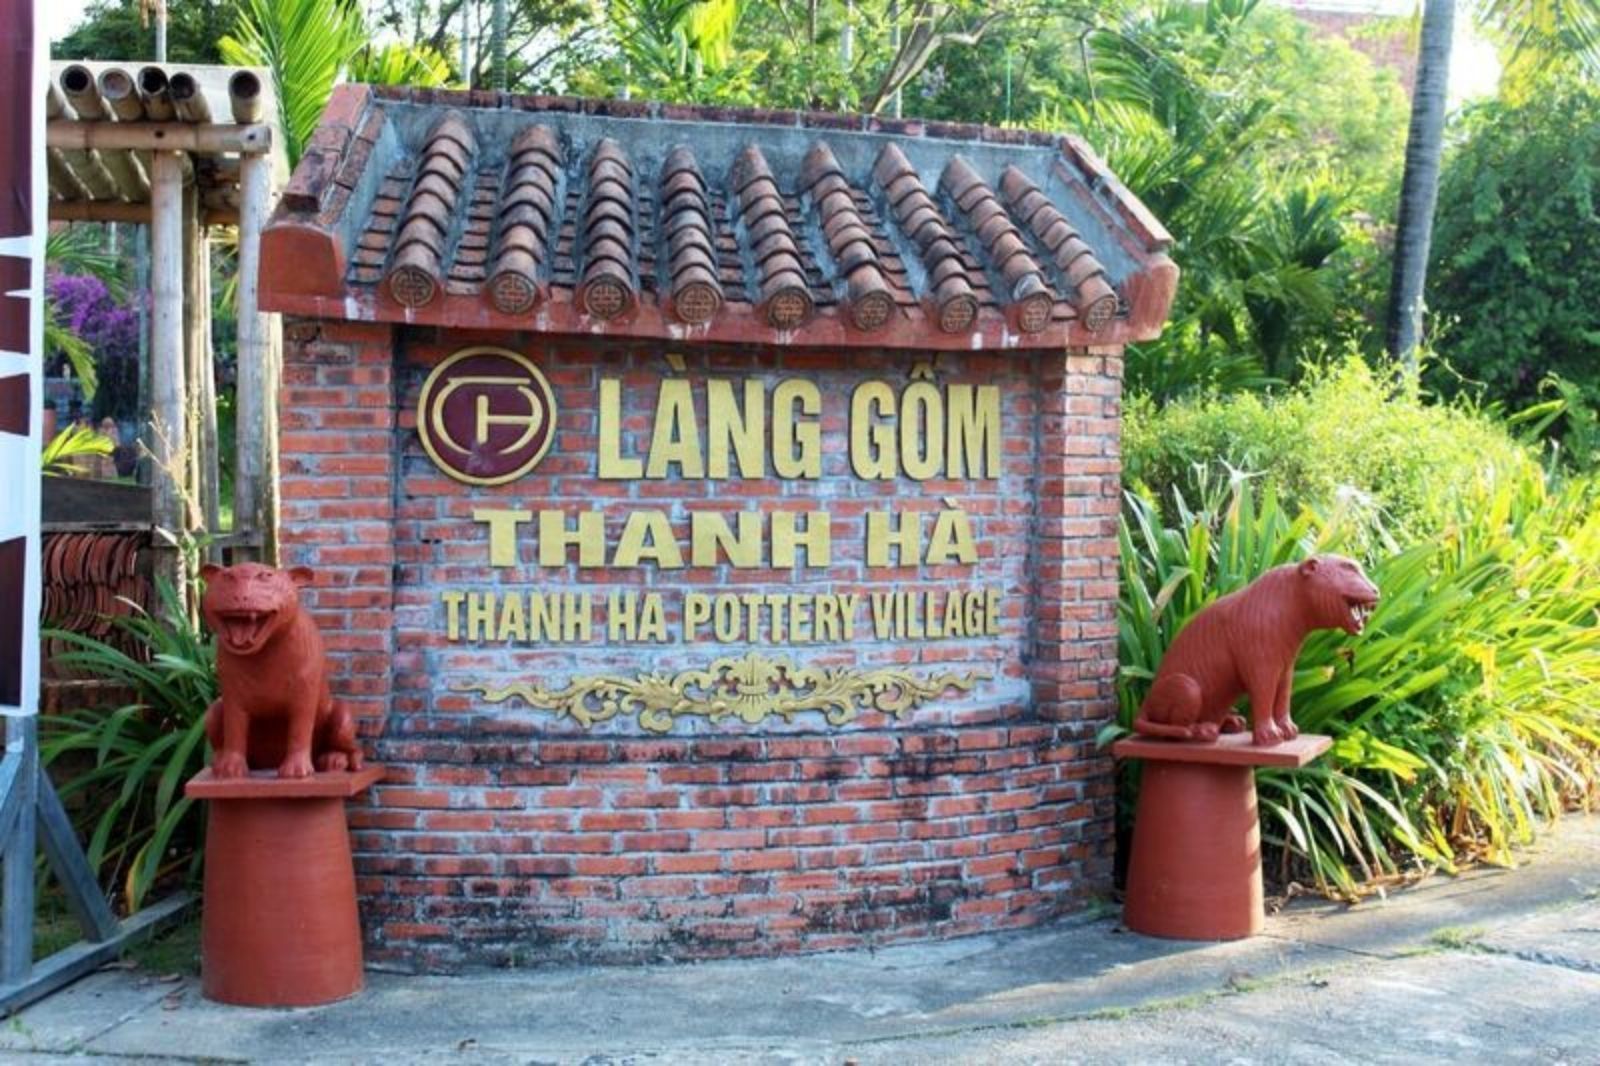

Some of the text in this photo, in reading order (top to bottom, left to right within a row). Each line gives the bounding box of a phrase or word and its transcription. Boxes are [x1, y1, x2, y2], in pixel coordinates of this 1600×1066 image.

[599, 352, 1001, 480] LÀNG GỐM
[473, 497, 979, 568] THANH HÀ
[442, 589, 1001, 643] THANH HA POTTERY VILLAGE
